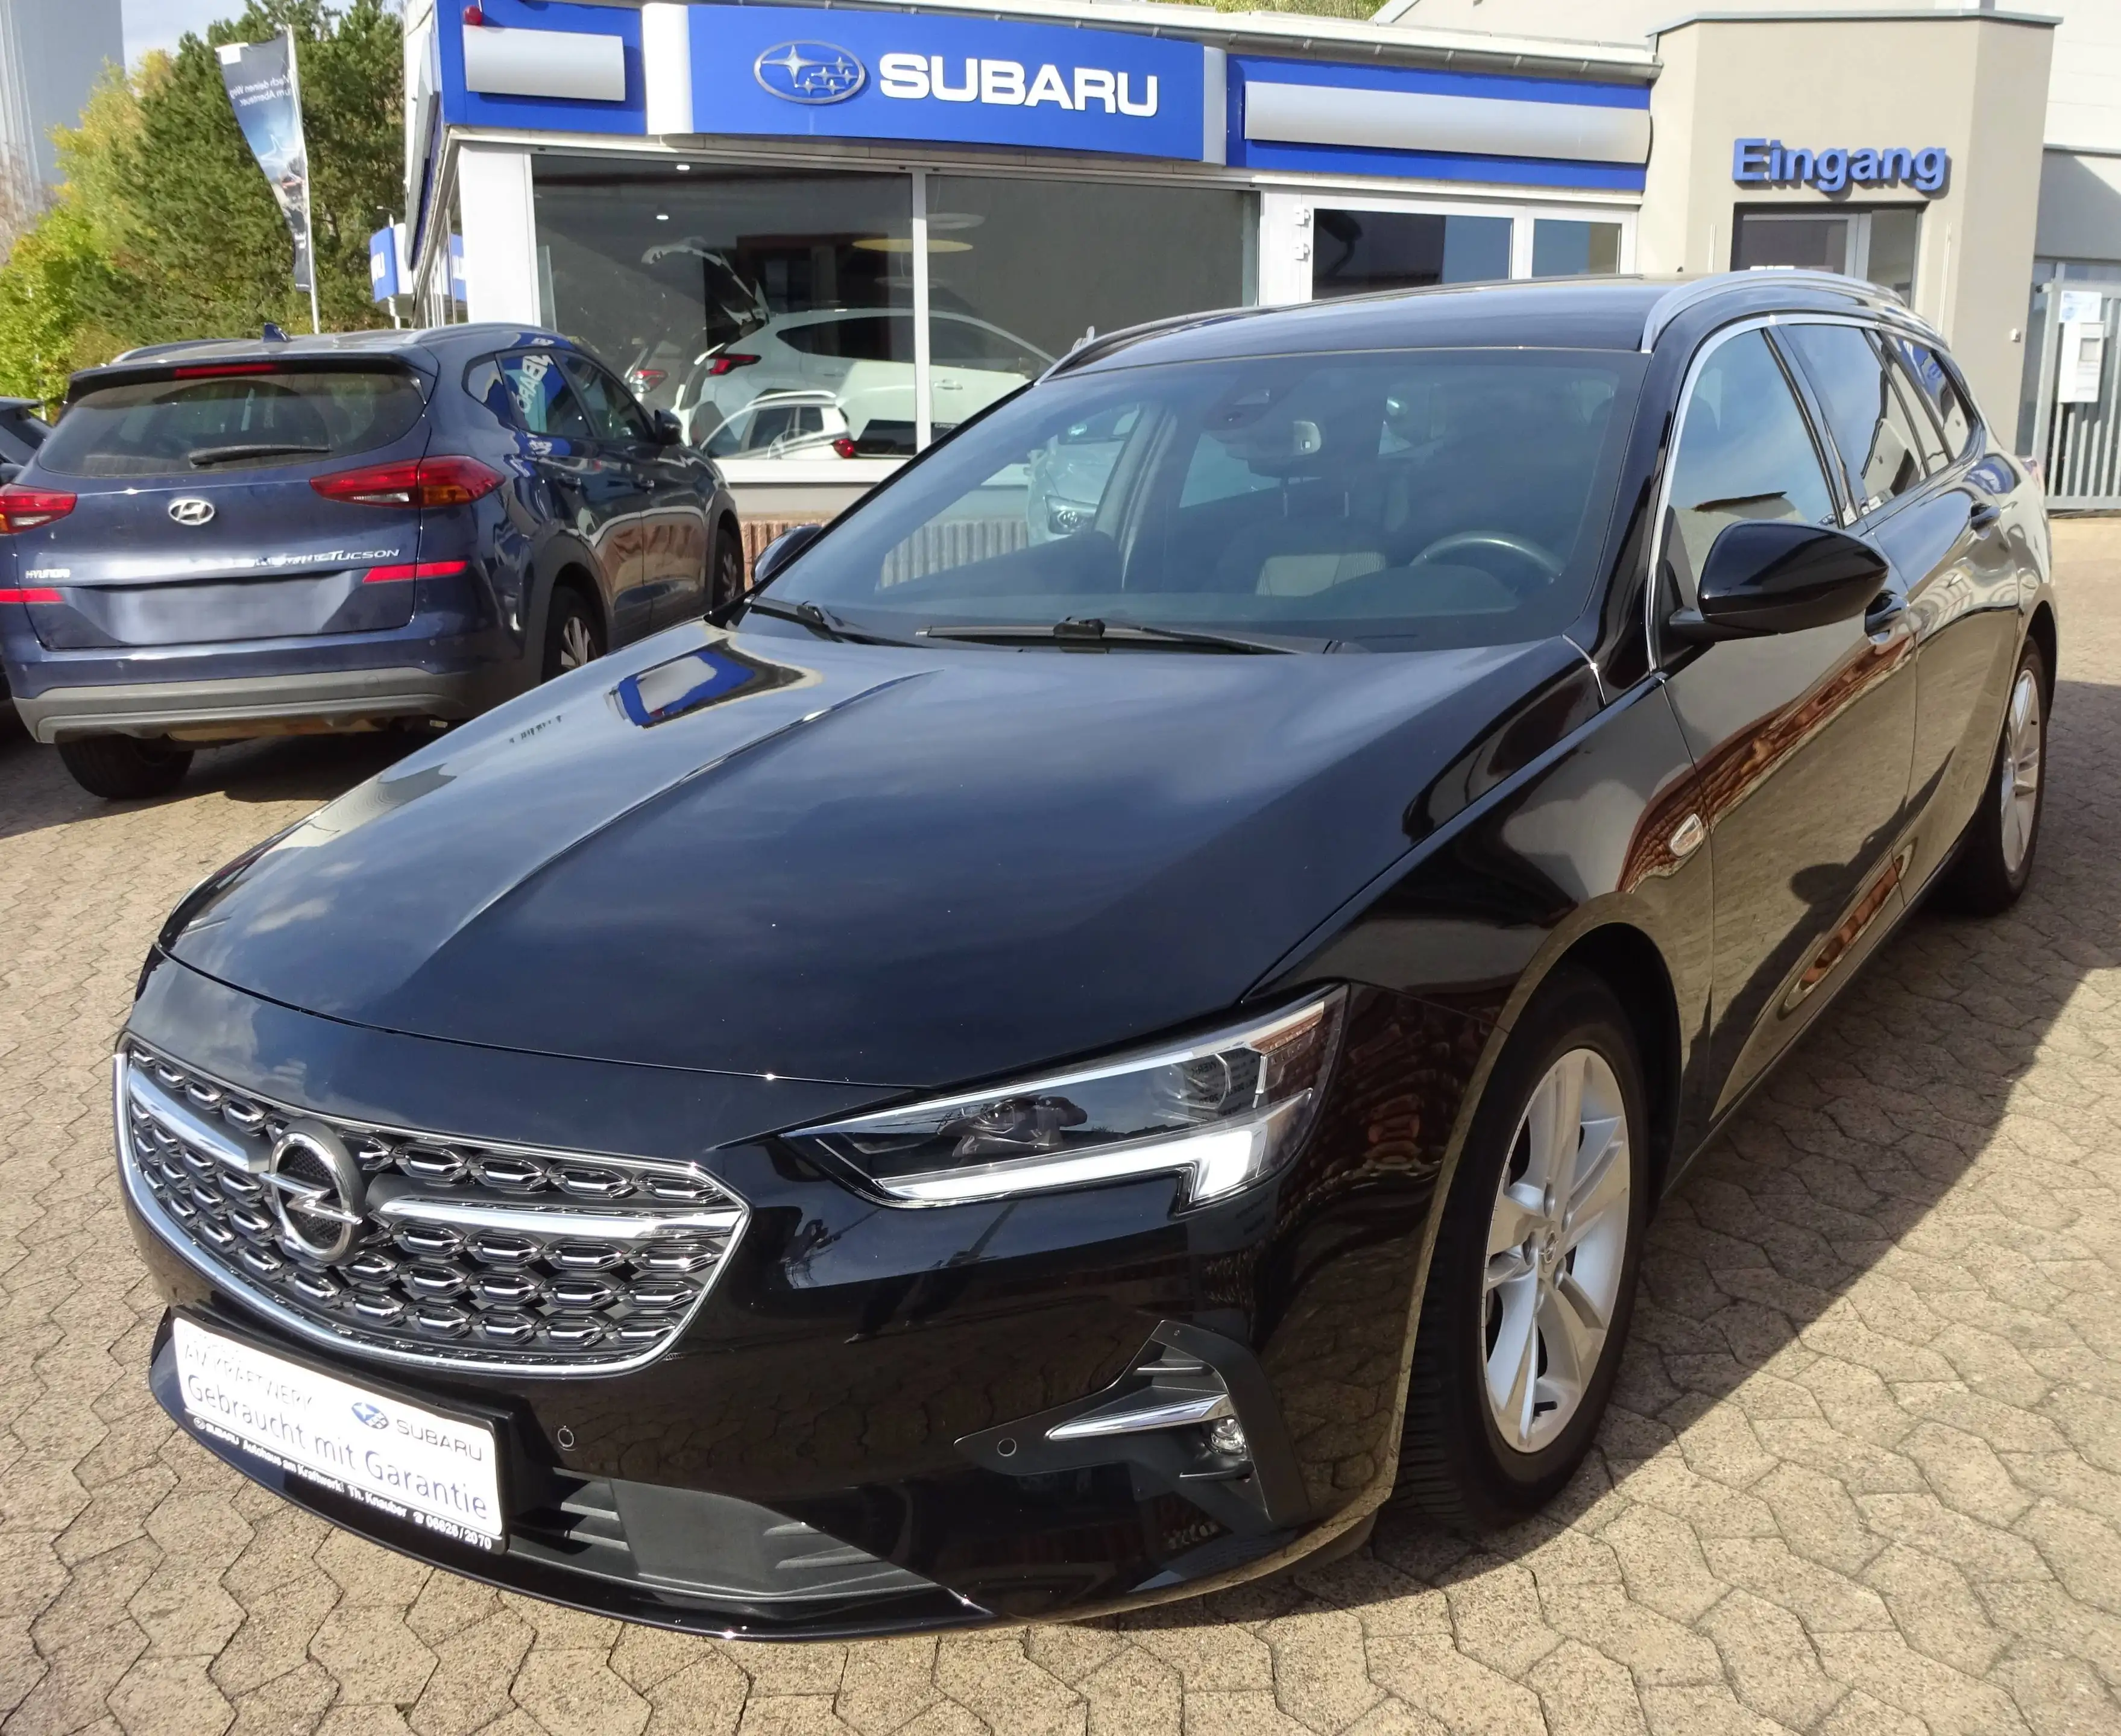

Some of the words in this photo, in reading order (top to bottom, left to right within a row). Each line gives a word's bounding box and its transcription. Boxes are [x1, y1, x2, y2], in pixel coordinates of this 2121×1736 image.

[879, 53, 1158, 117] SUBARU
[1732, 137, 1947, 192] Eingang
[188, 1374, 306, 1449] Gebraucht
[315, 1436, 356, 1470] mit
[365, 1450, 487, 1520] Garantie
[396, 1419, 482, 1461] SUBARU
